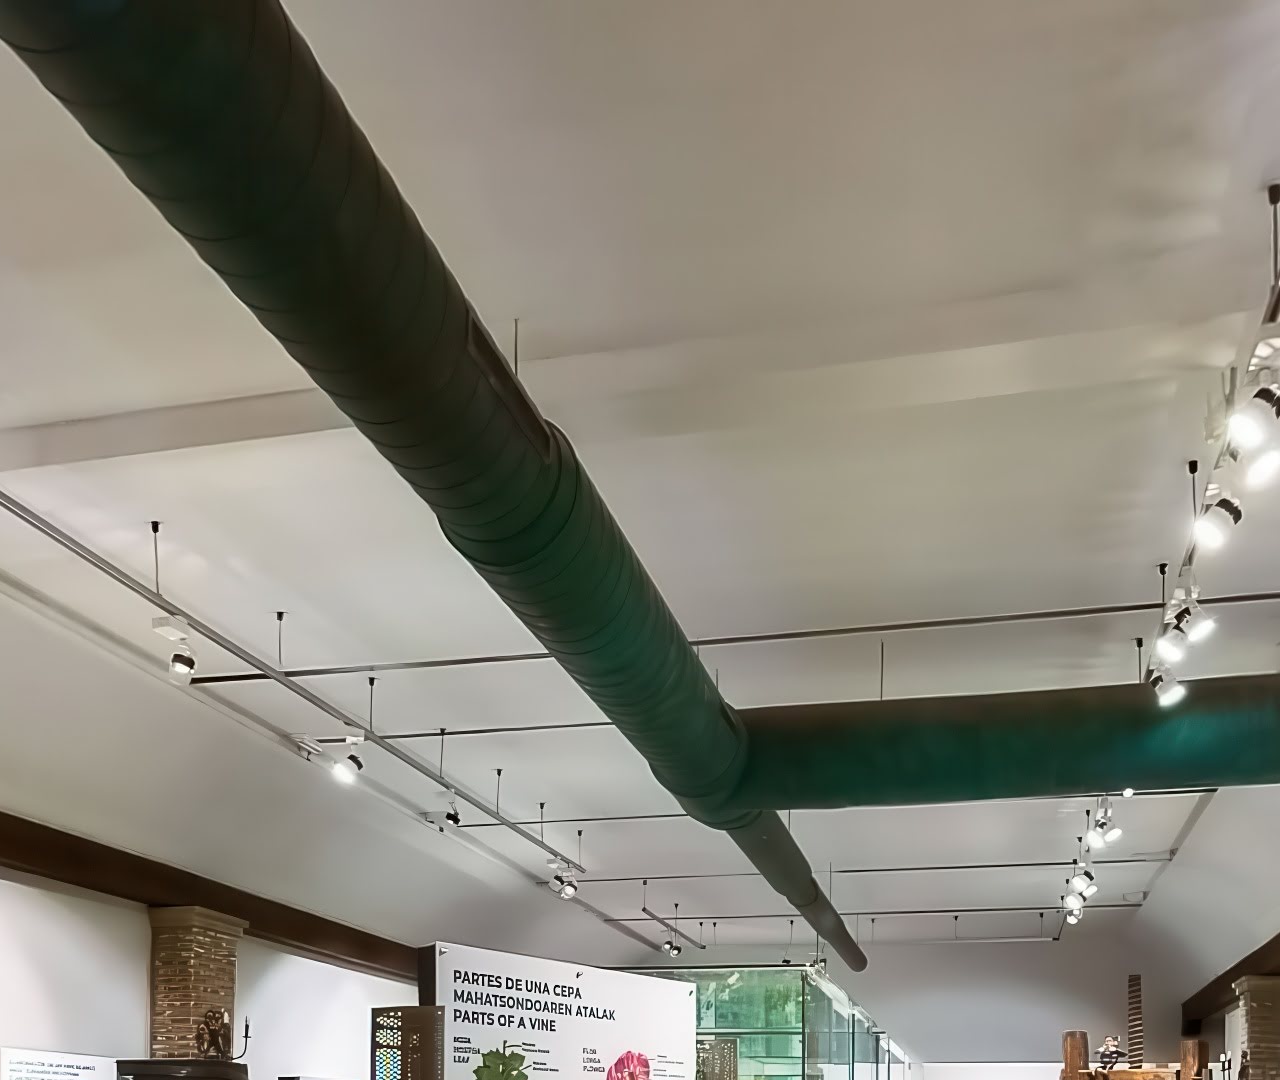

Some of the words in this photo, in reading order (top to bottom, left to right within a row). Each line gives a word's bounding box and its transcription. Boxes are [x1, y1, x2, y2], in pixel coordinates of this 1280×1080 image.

[453, 970, 502, 988] PARTES
[505, 977, 522, 991] DE
[525, 979, 550, 995] UNA
[553, 985, 582, 999] CEPA
[453, 989, 572, 1016] MAHATSONDOAREN
[575, 1005, 615, 1021] ATALAK
[453, 1009, 494, 1025] PARTS
[497, 1014, 515, 1027] OF
[517, 1017, 526, 1029] A
[529, 1017, 556, 1032] VINE
